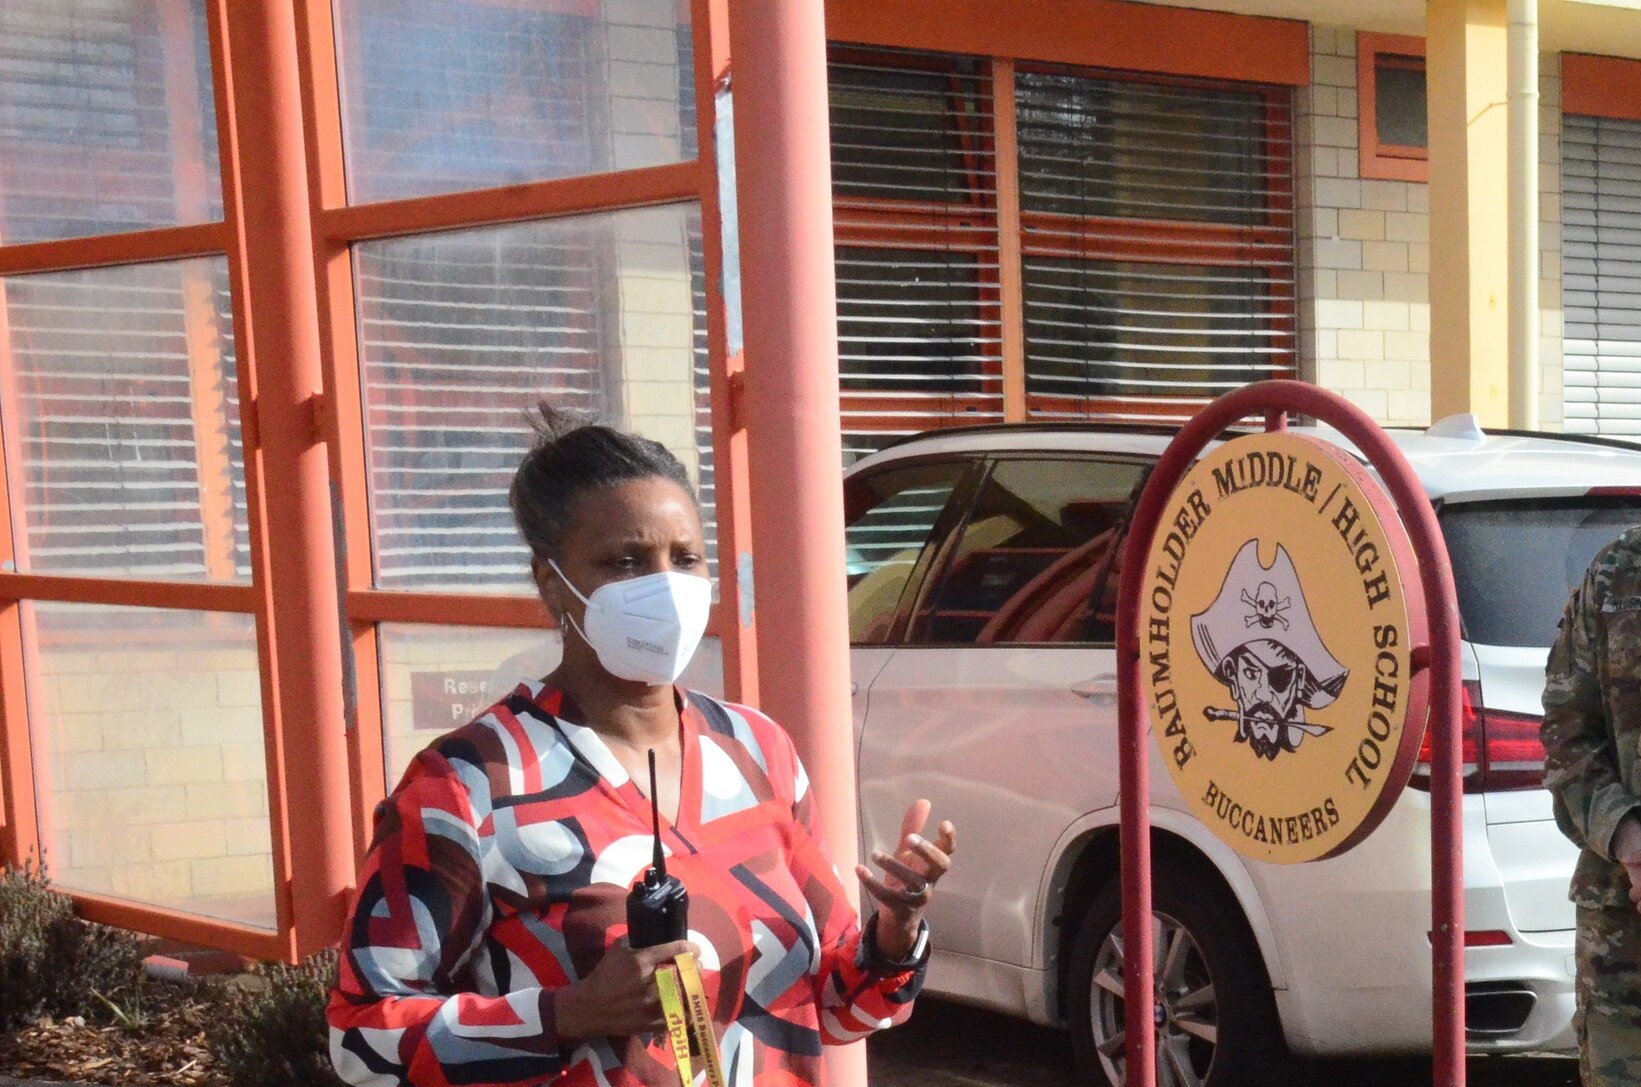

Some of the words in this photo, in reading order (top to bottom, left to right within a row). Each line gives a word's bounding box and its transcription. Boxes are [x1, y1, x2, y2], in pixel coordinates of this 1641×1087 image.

[1331, 496, 1390, 610] HIGH
[1148, 489, 1211, 770] BAUMHOLDER
[1344, 624, 1399, 790] SCHOOL
[1201, 780, 1340, 845] BUCCANEERS
[698, 1024, 716, 1079] Buccaneers
